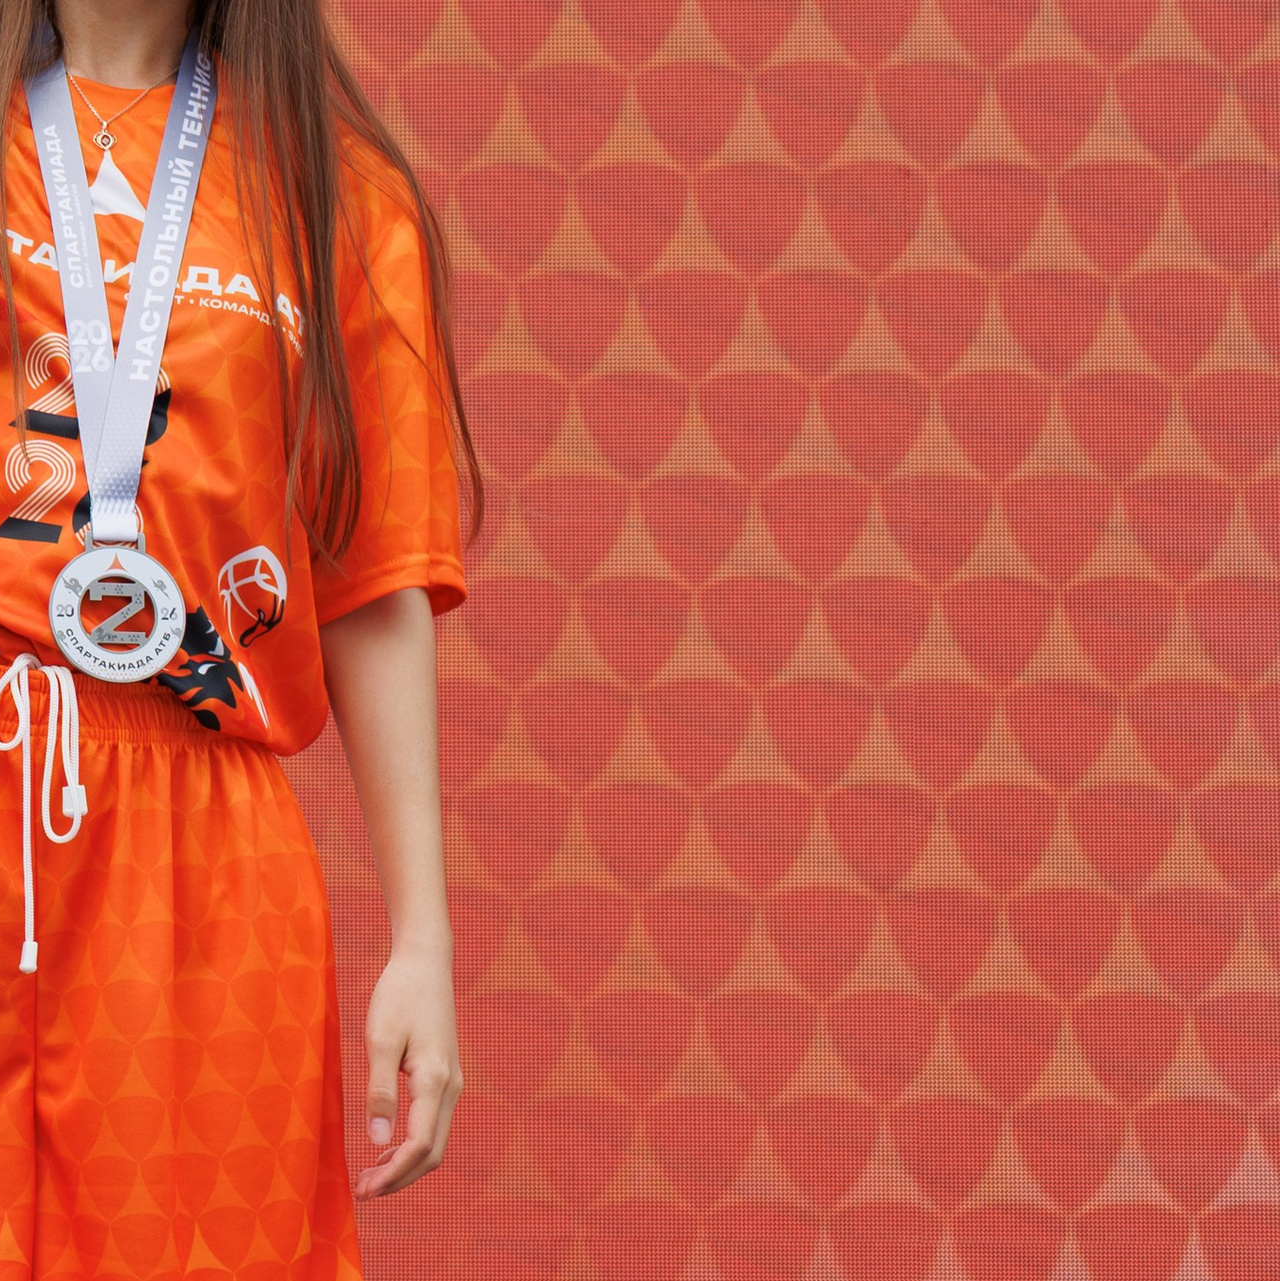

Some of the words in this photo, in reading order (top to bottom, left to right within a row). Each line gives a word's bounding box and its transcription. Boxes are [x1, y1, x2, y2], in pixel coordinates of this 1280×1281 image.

[43, 124, 84, 288] СПАРТАКИАДА
[129, 160, 195, 382] НАСТОЛЬНЫЙ
[70, 319, 108, 346] 20
[72, 346, 111, 373] 26
[56, 604, 75, 618] 20
[160, 607, 179, 621] 26
[65, 628, 154, 671] СПАРТАКИАДА
[154, 632, 172, 657] АТБ
